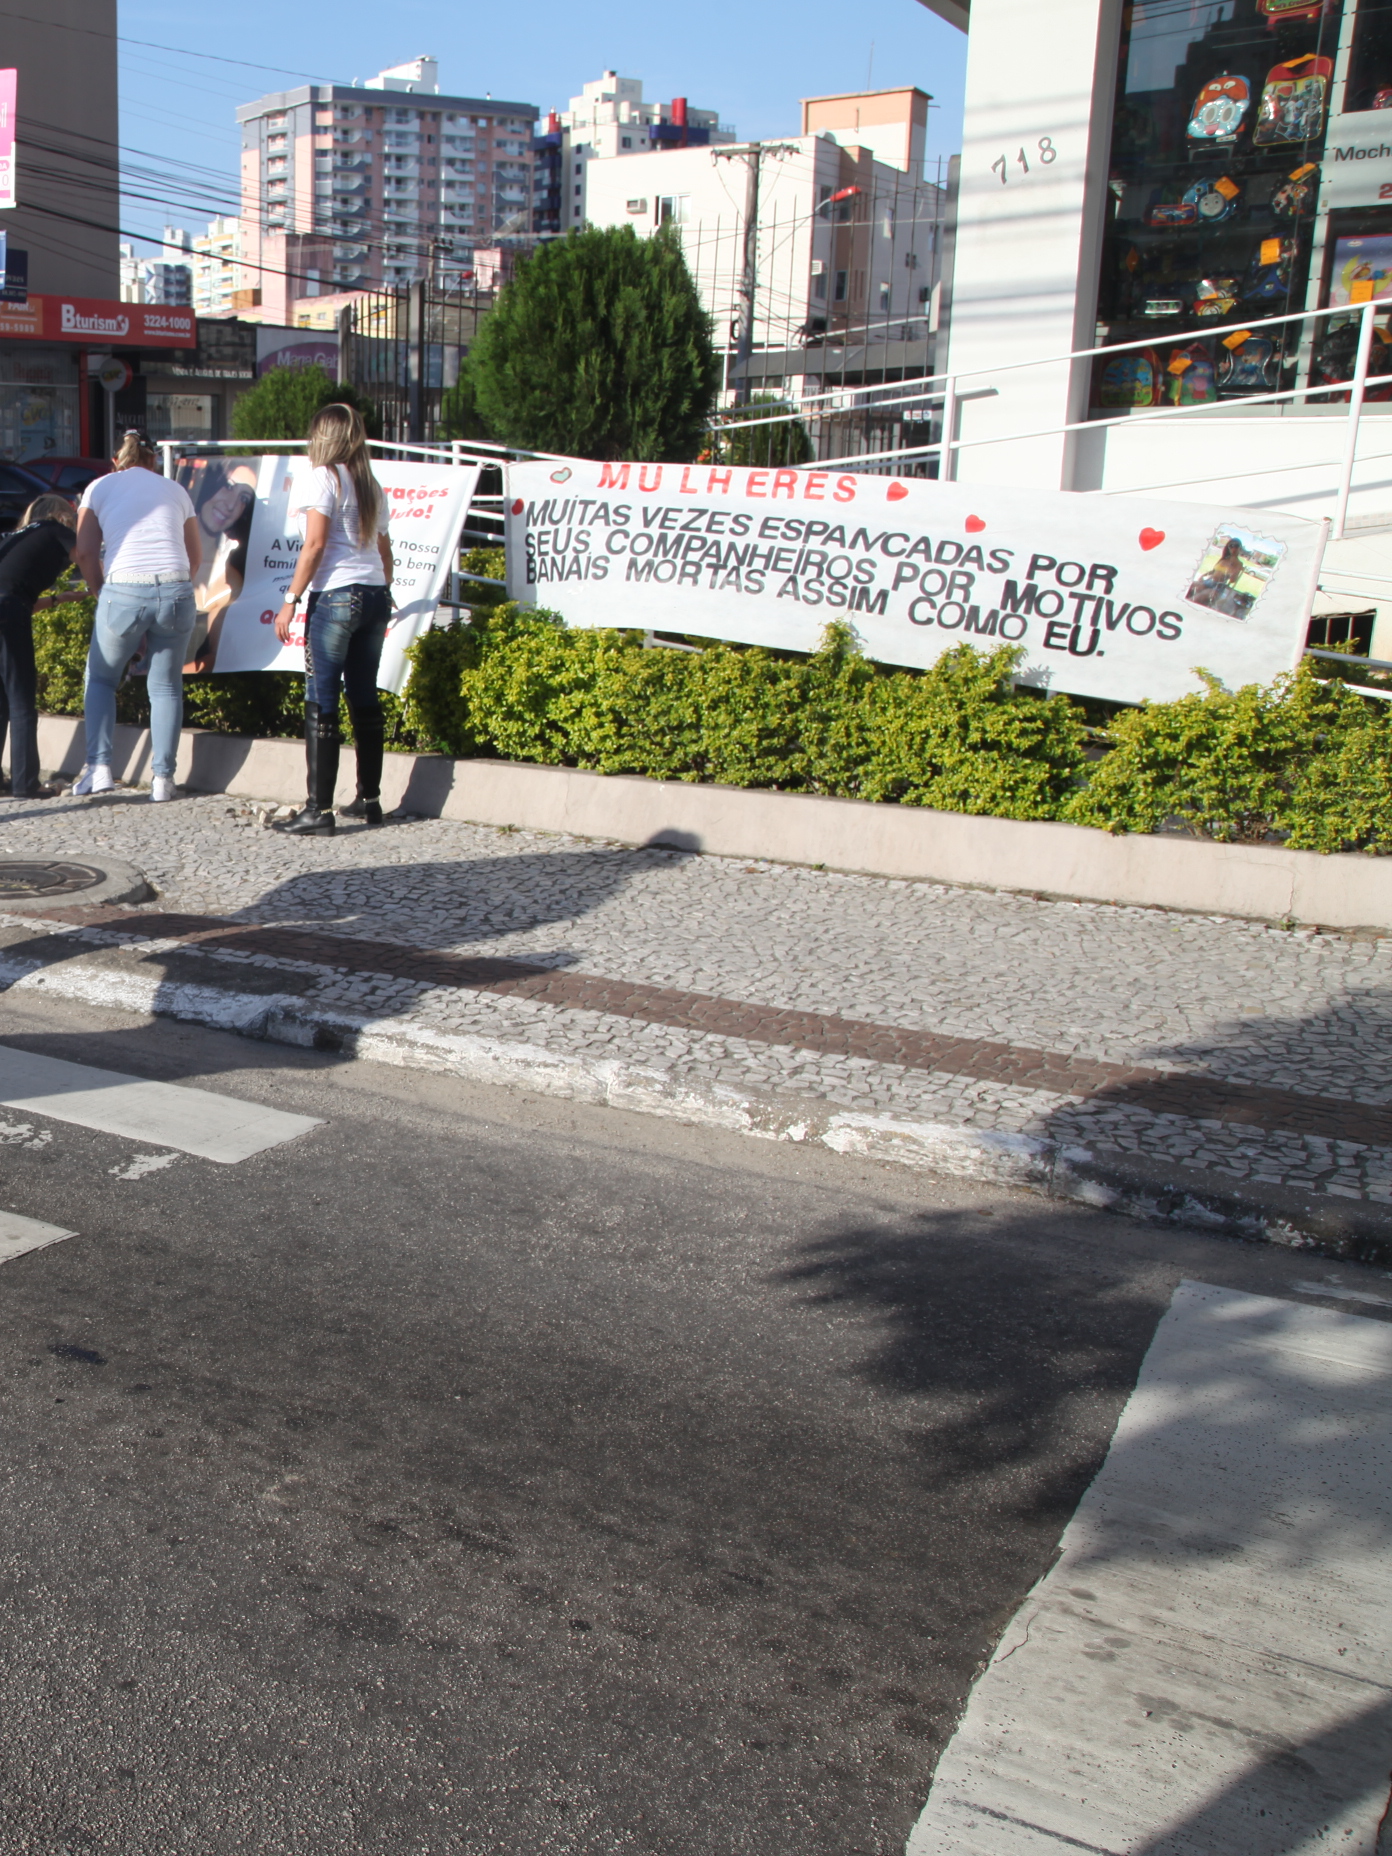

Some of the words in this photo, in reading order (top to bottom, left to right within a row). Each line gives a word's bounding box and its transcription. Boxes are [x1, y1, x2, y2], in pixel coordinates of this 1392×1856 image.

[144, 314, 191, 330] 3224-1000
[264, 555, 297, 570] famíl
[406, 557, 437, 573] bem
[271, 539, 282, 551] A
[399, 539, 440, 554] nossa
[642, 506, 753, 538] VEZES
[757, 516, 1015, 574] ESPANCADAS
[1025, 553, 1118, 595] POR
[525, 527, 592, 557] SEUS
[891, 561, 976, 604] POR
[999, 578, 1184, 641] MOTIVOS
[625, 556, 766, 595] MORTAS
[776, 574, 890, 616] ASSIM
[907, 596, 1028, 641] COMO
[1042, 620, 1105, 657] EU.
